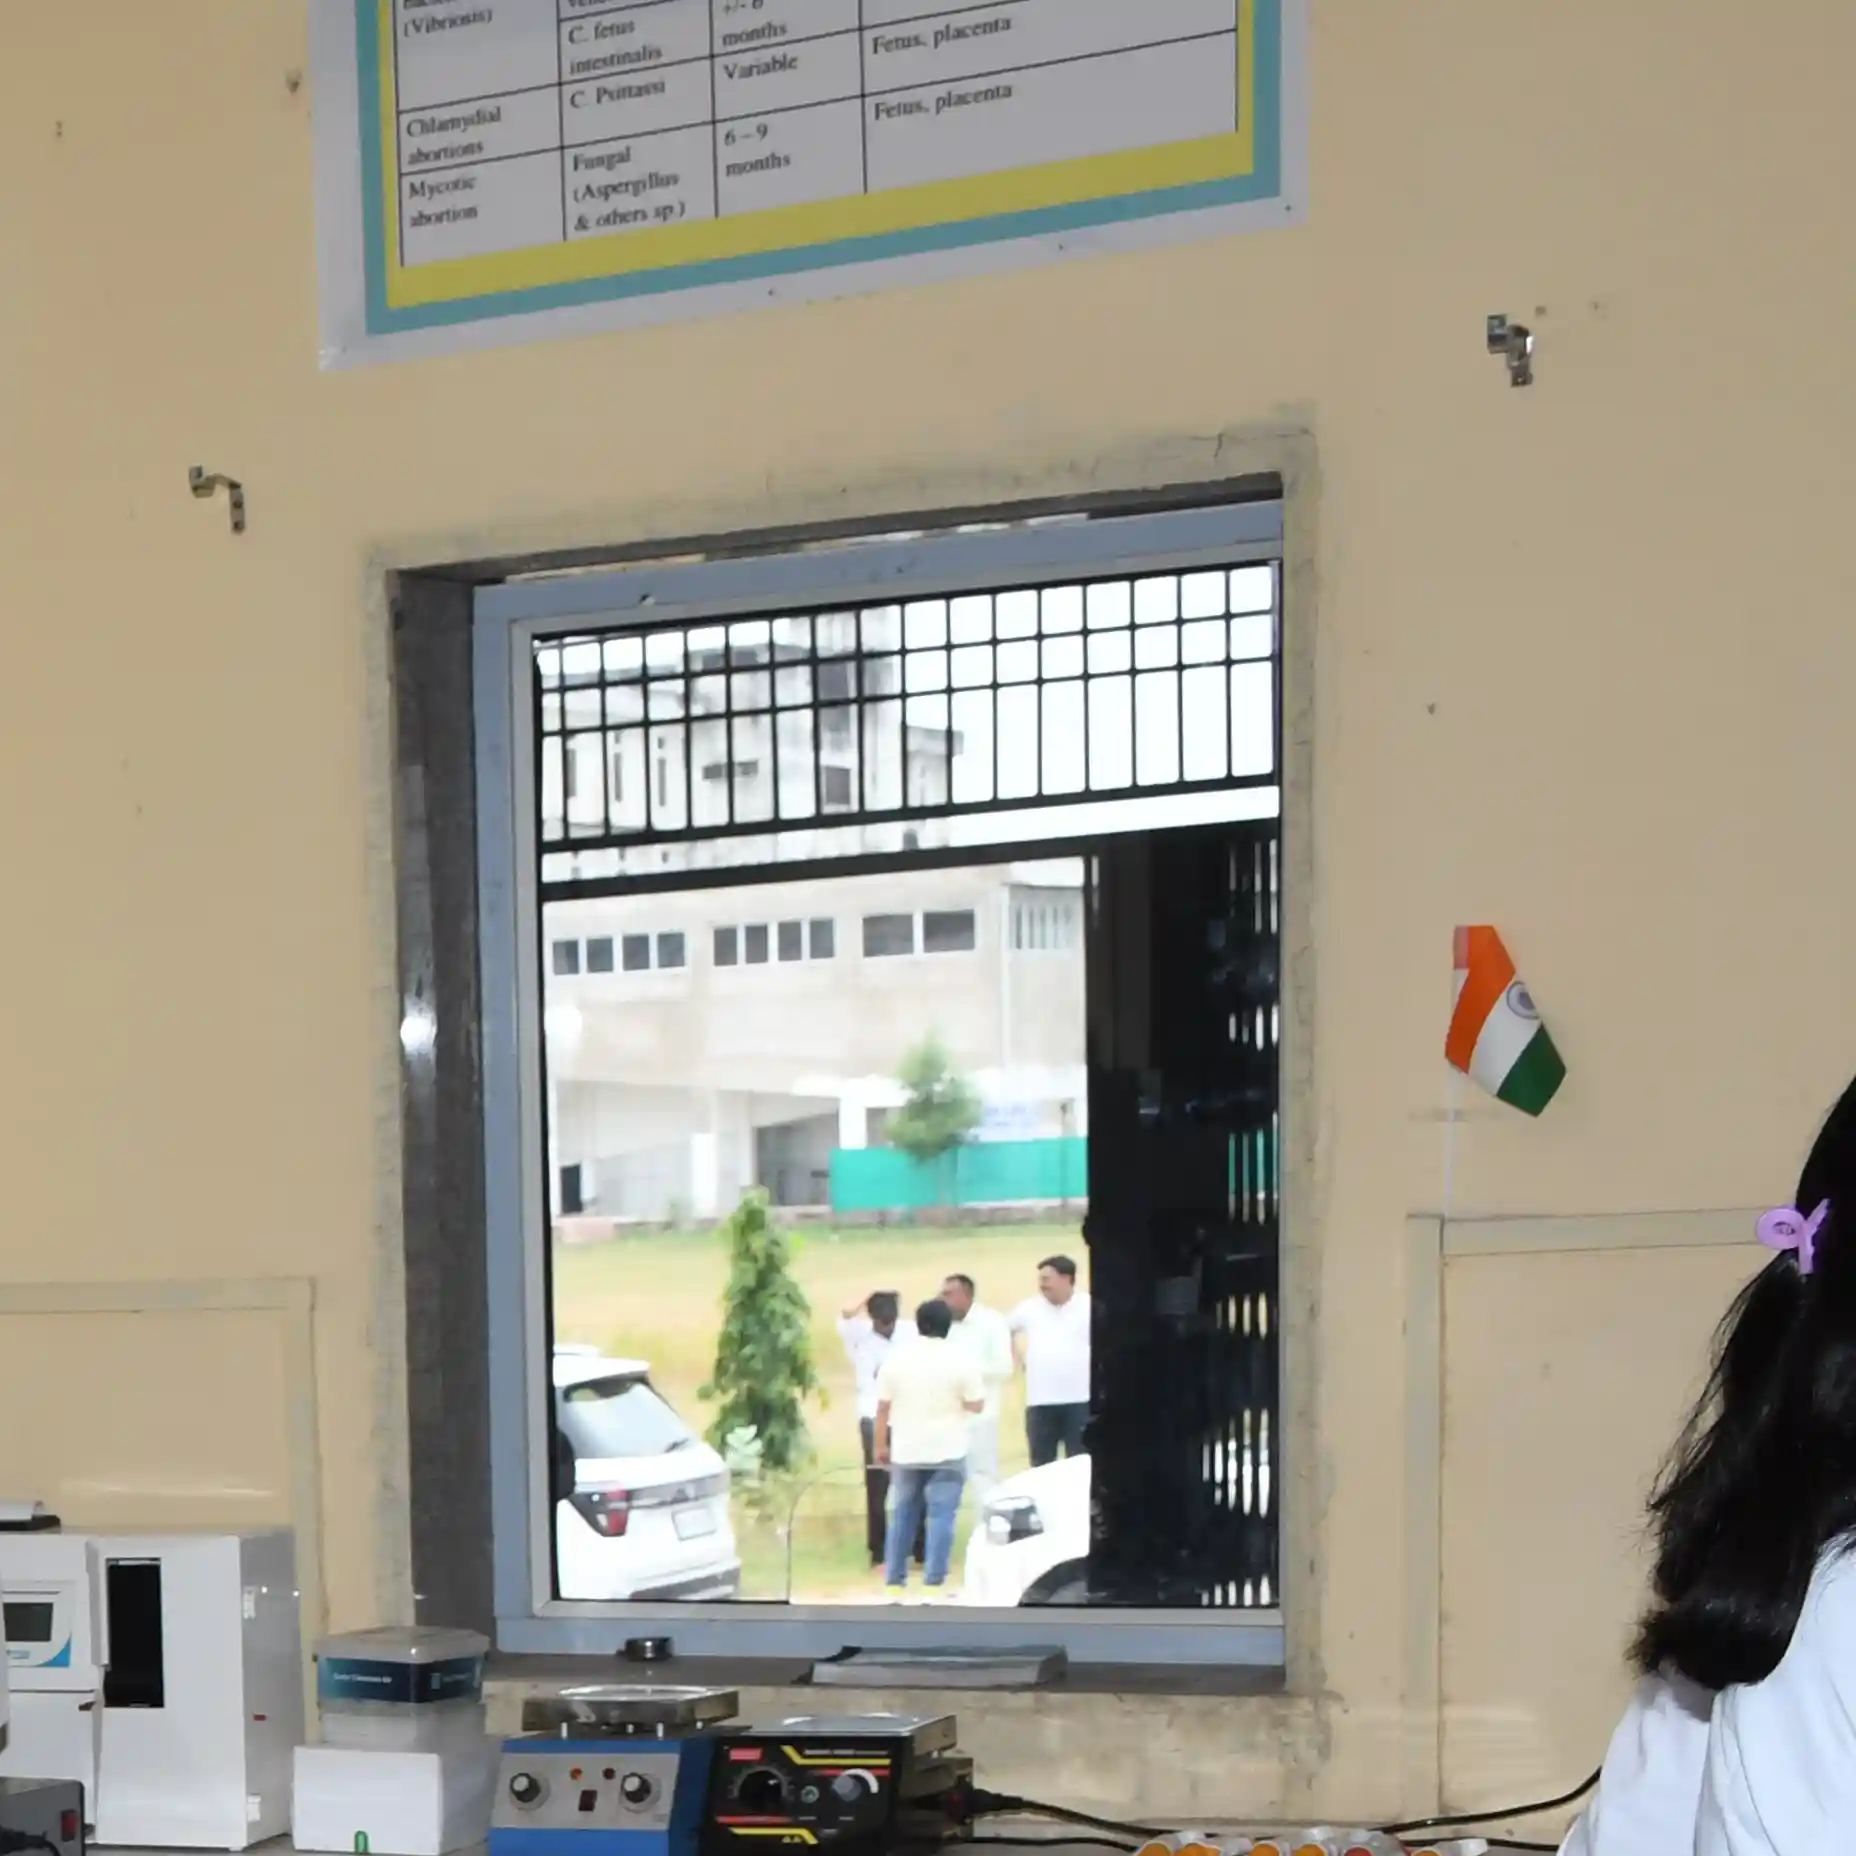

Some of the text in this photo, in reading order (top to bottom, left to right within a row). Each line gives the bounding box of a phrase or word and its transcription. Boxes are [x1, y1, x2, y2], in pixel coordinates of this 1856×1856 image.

[722, 21, 788, 47] months
[933, 17, 1012, 49] placenta
[723, 53, 799, 80] Variable
[934, 84, 1013, 116] placenta
[757, 123, 768, 140] 9
[573, 146, 631, 172] Fungal
[725, 151, 791, 178] months
[409, 175, 478, 201] Mycotic
[410, 204, 478, 229] abortion
[596, 207, 649, 226] others
